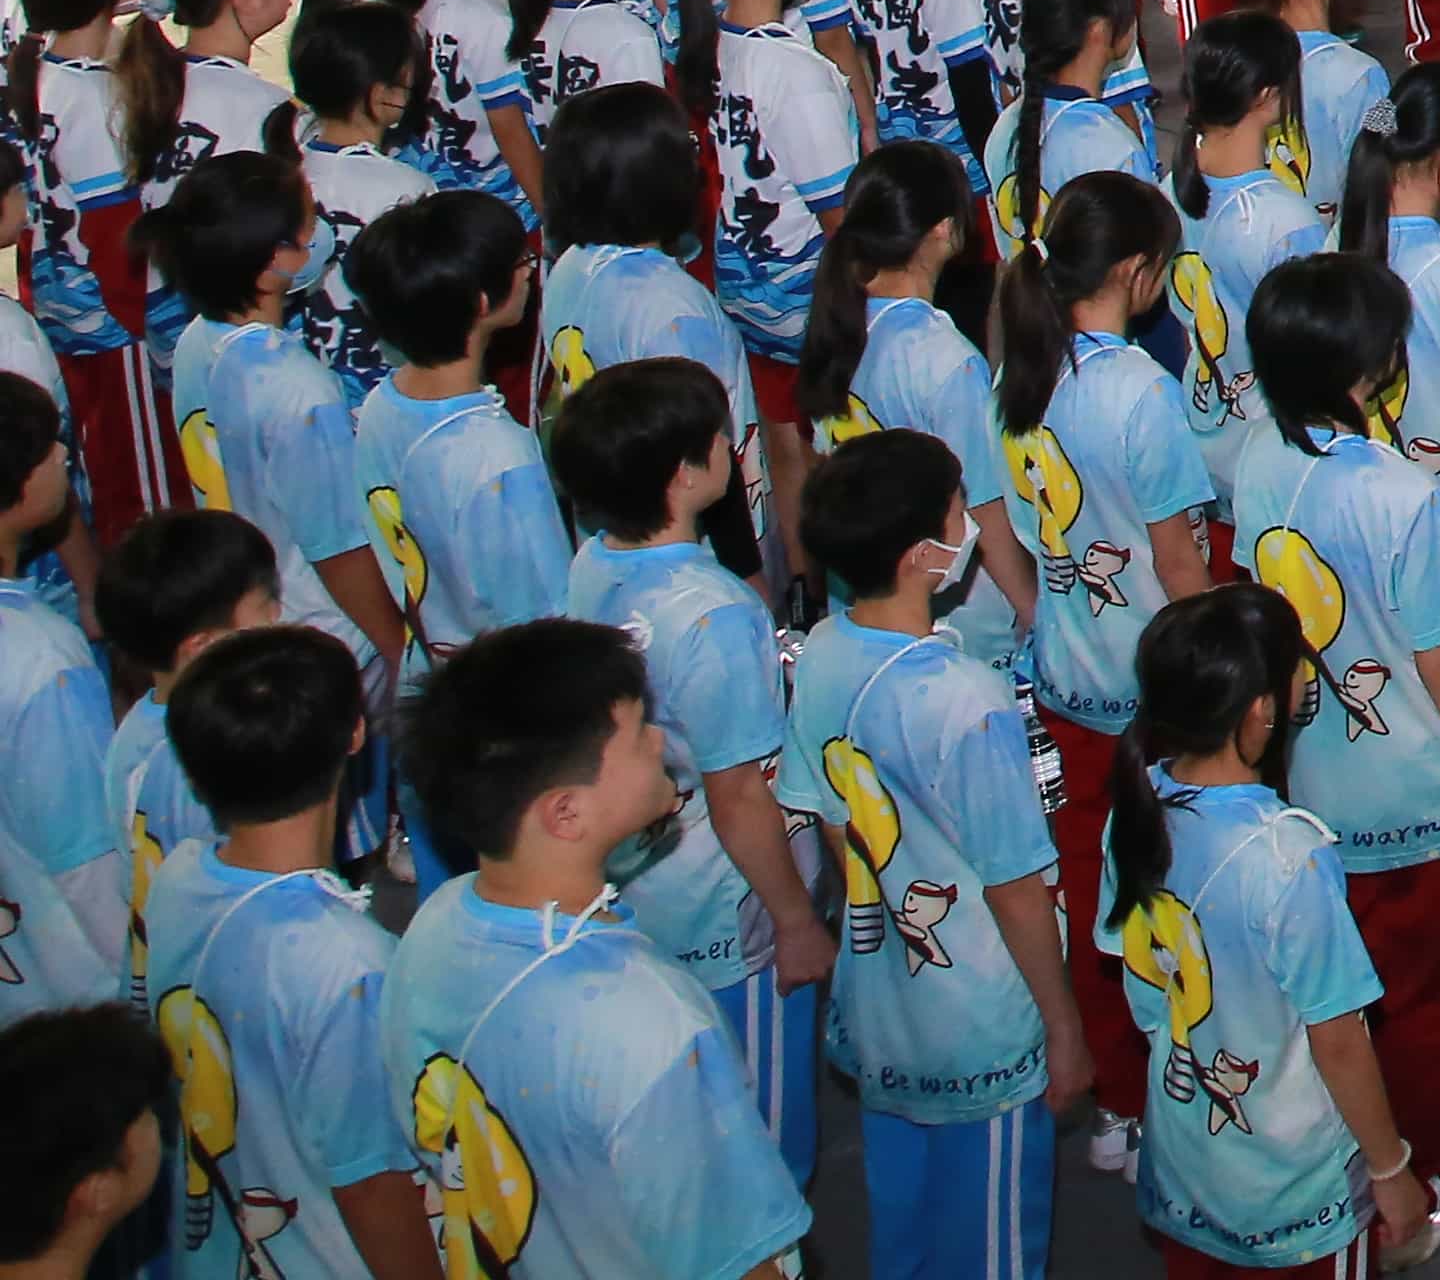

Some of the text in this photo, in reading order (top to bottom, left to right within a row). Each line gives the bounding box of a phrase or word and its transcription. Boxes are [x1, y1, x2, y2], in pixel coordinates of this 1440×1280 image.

[1066, 691, 1094, 711] Be
[880, 1041, 1044, 1095] Be warmer
